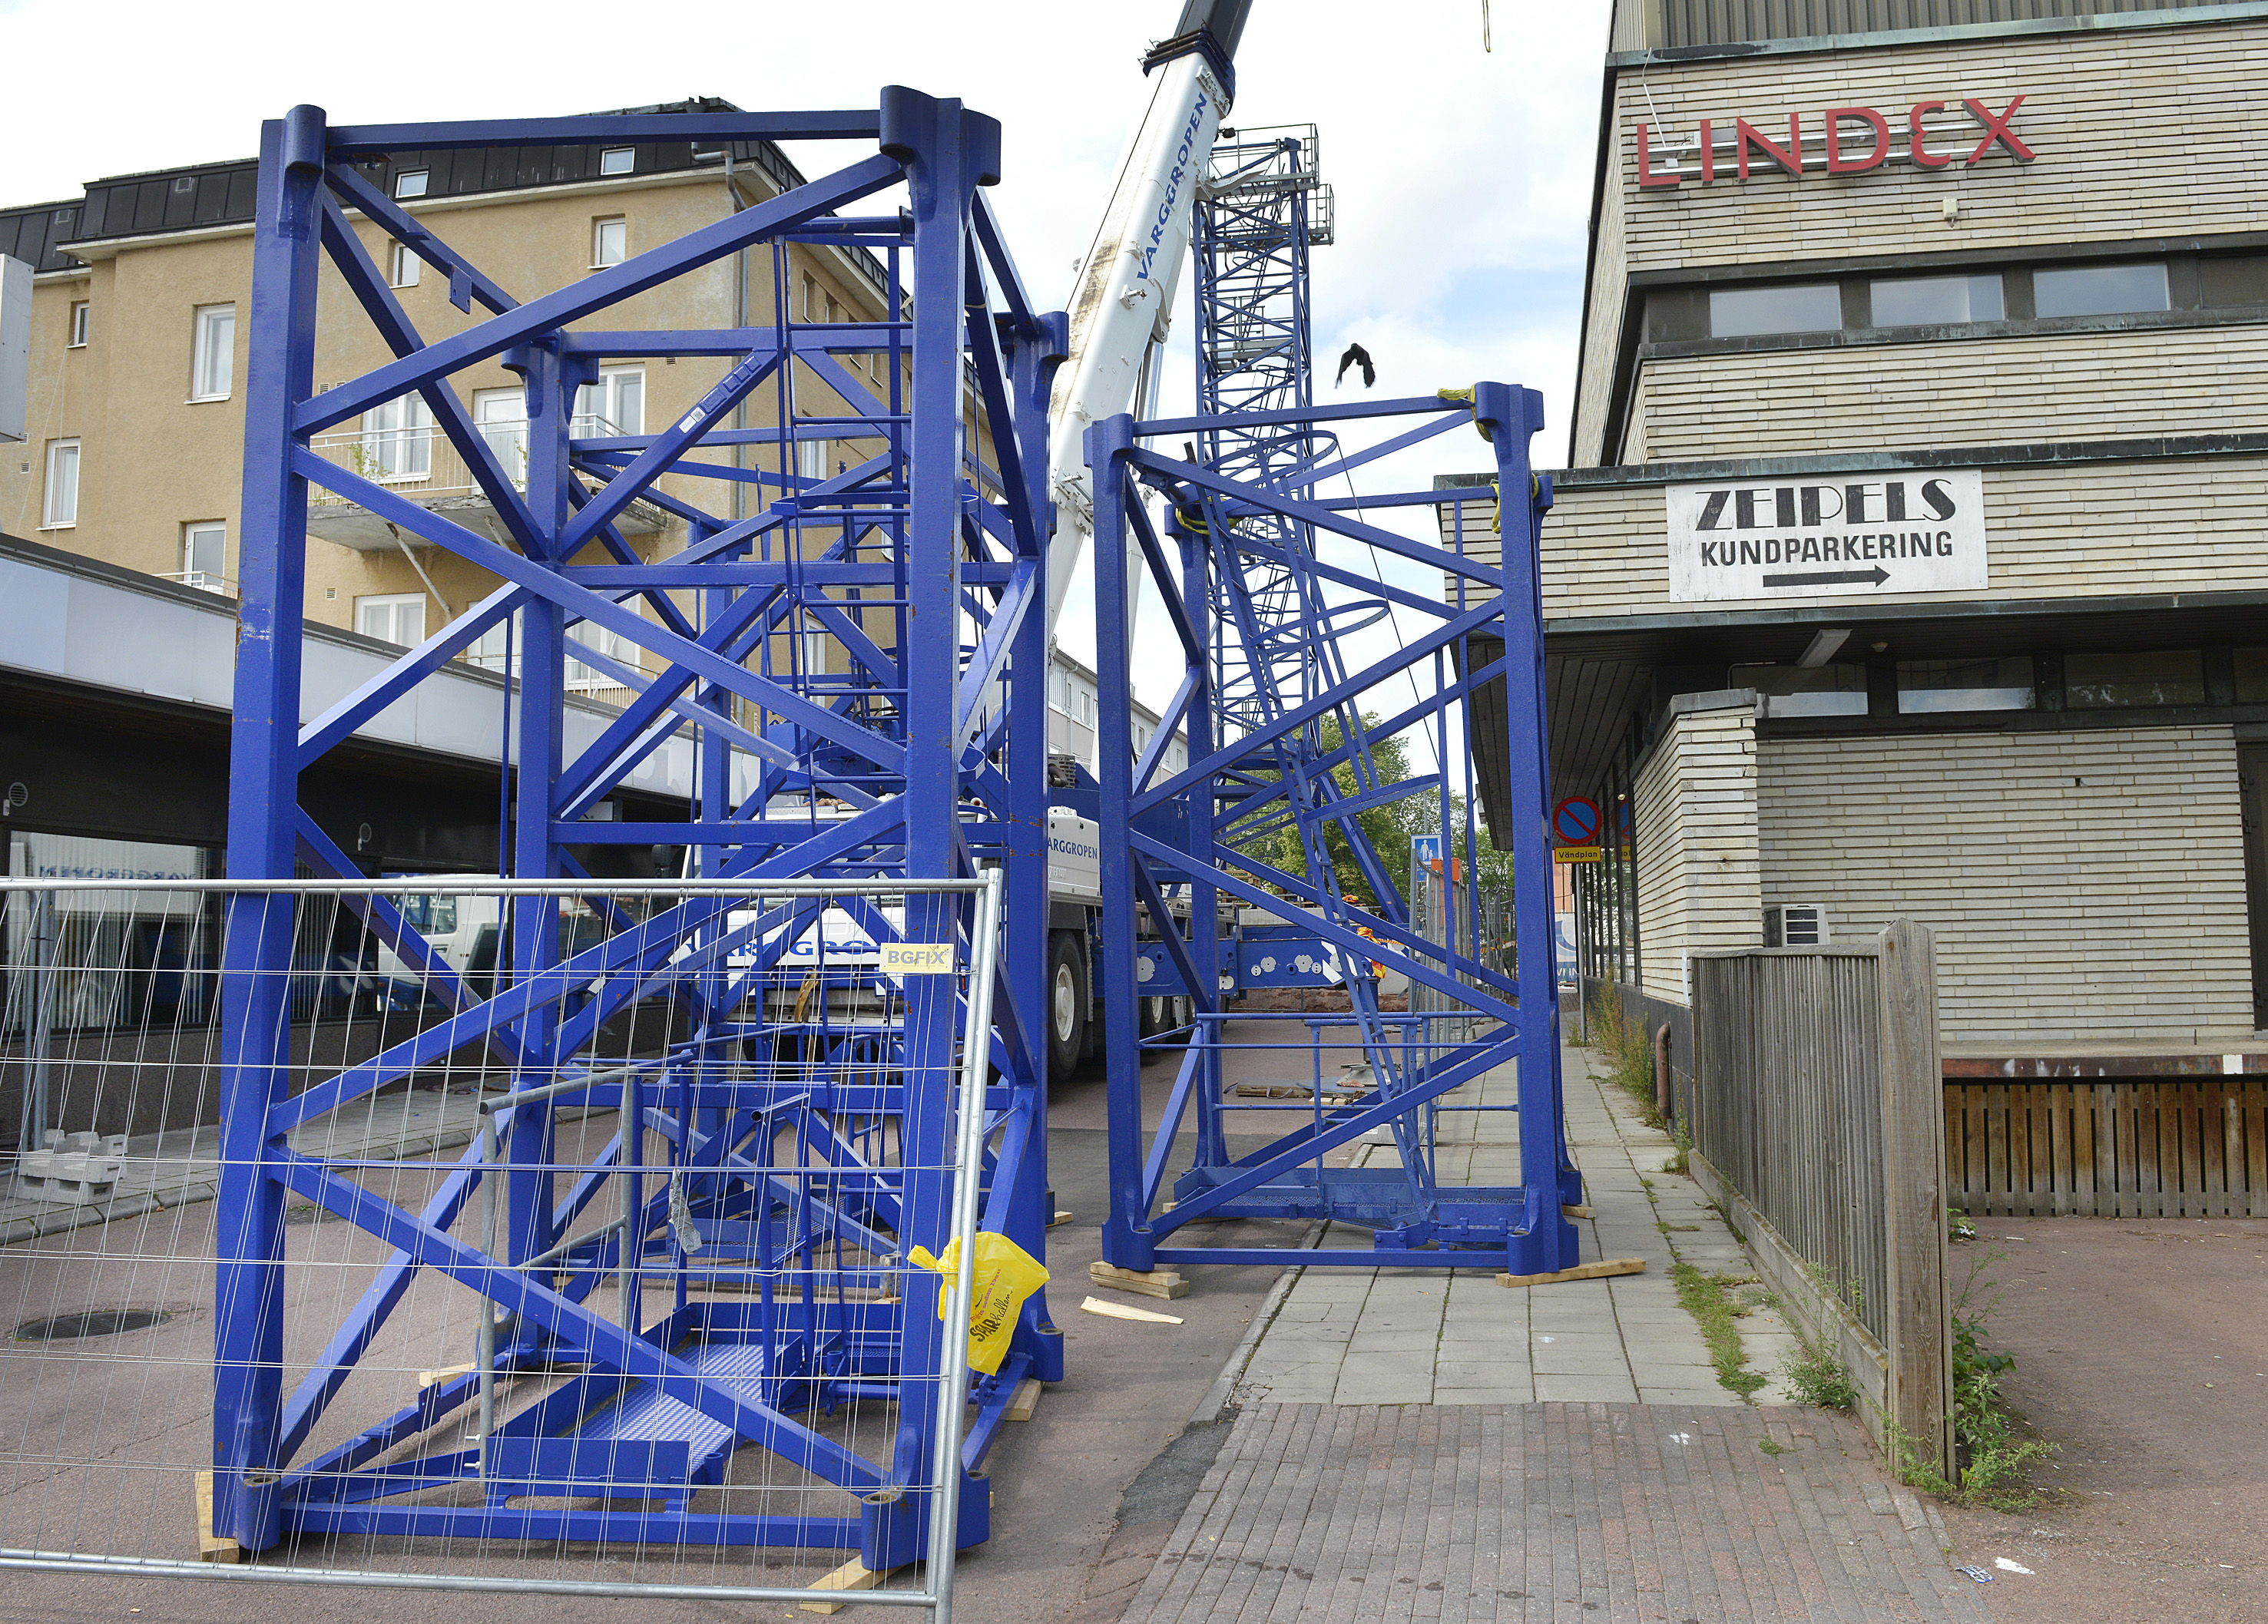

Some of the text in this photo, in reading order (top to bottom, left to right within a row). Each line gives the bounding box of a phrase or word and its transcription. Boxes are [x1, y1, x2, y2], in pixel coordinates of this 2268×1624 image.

[1637, 94, 2037, 188] LINDEX
[1137, 92, 1207, 279] VARGGROPEN
[1695, 478, 1955, 531] ZEIPELS
[1701, 531, 1953, 567] KUNDPARKERING
[1048, 837, 1098, 860] ARGGROPEN
[1558, 851, 1598, 859] Vändplan
[888, 951, 945, 964] BGFIX
